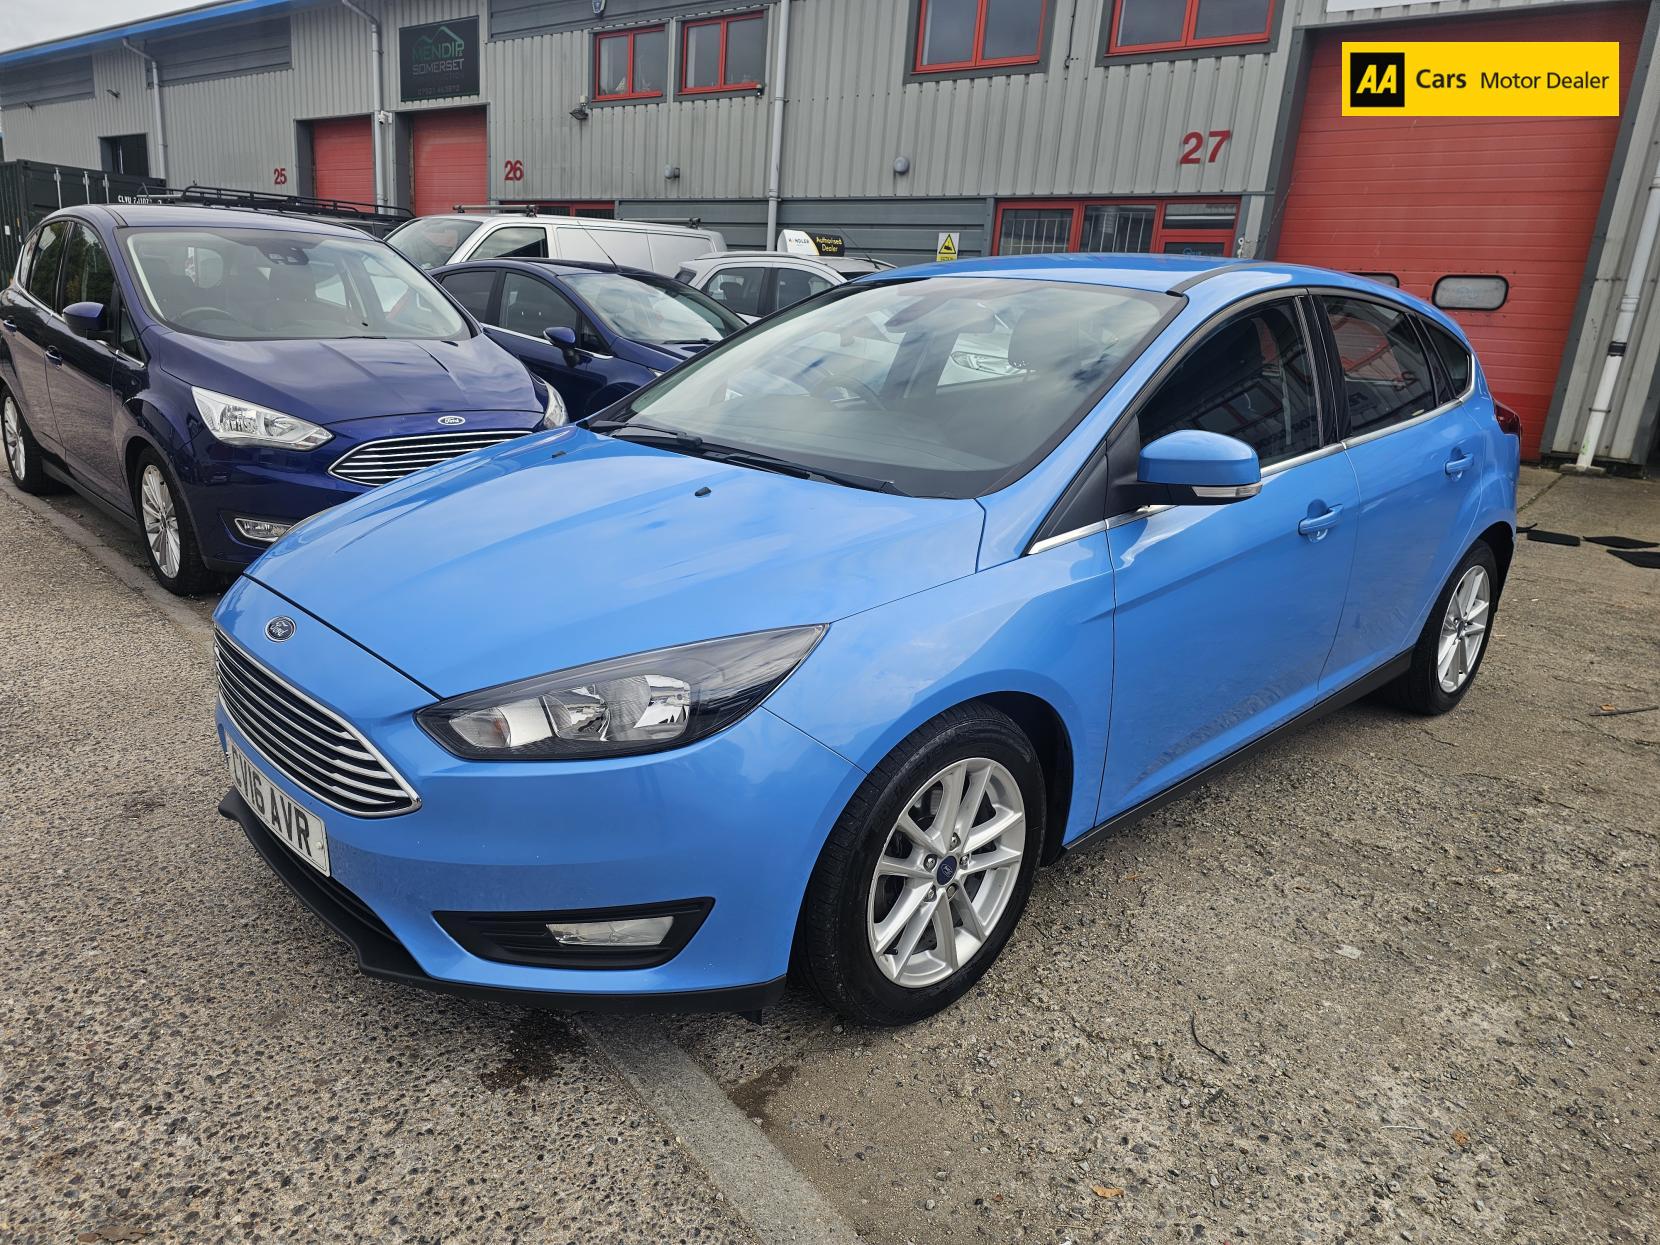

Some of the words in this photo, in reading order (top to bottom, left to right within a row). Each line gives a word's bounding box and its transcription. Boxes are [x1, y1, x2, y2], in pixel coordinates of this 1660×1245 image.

[413, 40, 465, 63] MENDIP
[412, 58, 465, 75] SOMERSET
[1180, 130, 1231, 165] 27
[273, 168, 287, 185] 25
[504, 160, 524, 181] 26
[821, 244, 839, 252] Dealer
[270, 786, 313, 858] AVR
